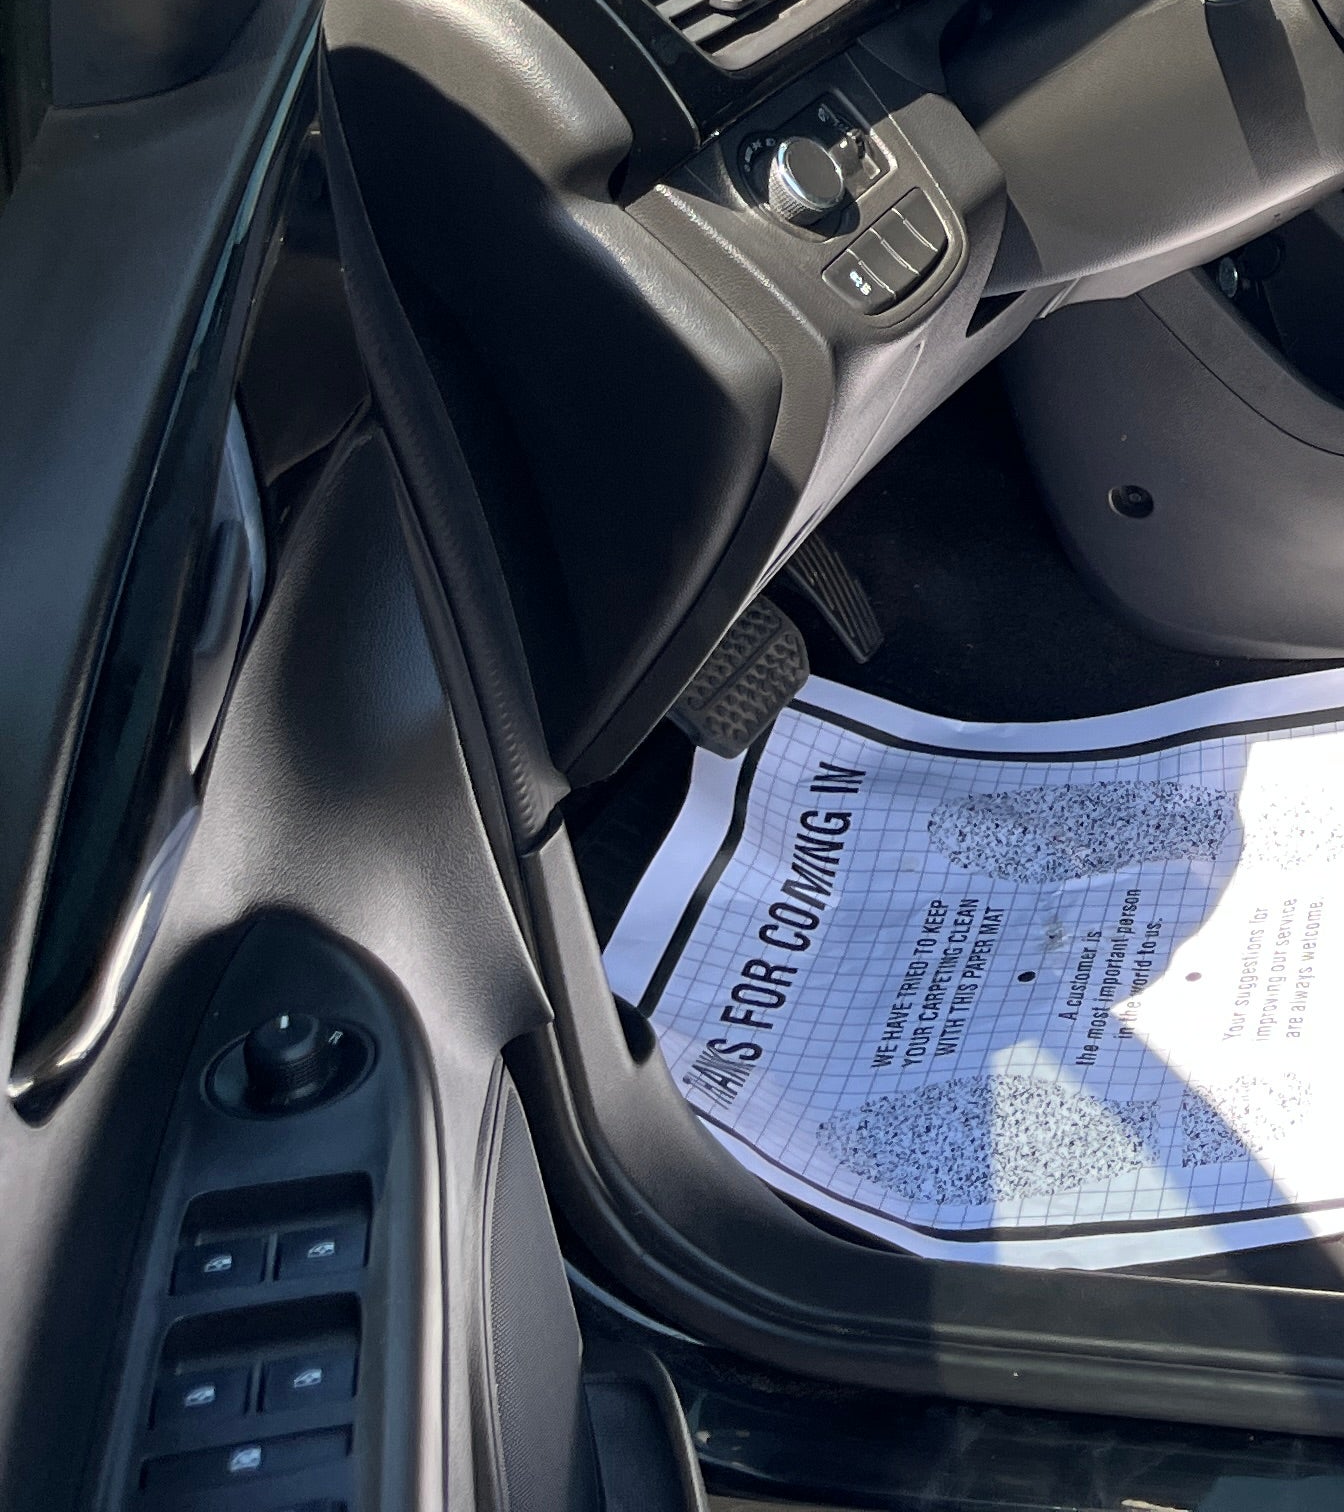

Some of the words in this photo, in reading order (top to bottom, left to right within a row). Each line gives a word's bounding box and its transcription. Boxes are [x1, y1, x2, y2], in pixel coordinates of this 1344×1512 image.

[809, 761, 866, 793] IN
[758, 810, 852, 951] COMING
[921, 899, 949, 934] KEEP
[979, 906, 1004, 935] MAT
[1117, 888, 1141, 935] person
[1145, 918, 1163, 937] us.
[1276, 899, 1297, 946] service
[913, 938, 937, 956] TO
[1082, 930, 1102, 942] is
[1137, 940, 1157, 955] to
[962, 939, 995, 979] PAPER
[1066, 946, 1098, 1007] customer
[1093, 939, 1129, 1002] important
[1270, 950, 1287, 972] our
[719, 958, 799, 1029] FOR
[897, 961, 929, 998] TRIED
[901, 1026, 934, 1068] YOUR
[918, 947, 963, 1021] CARPETING
[948, 898, 980, 943] CLEAN
[1130, 959, 1153, 996] world
[1222, 1012, 1246, 1041] Your
[1235, 929, 1265, 1006] suggestions
[1289, 966, 1315, 1012] always
[949, 983, 978, 1014] THIS
[1058, 1012, 1078, 1021] A
[1119, 1001, 1141, 1022] the
[1255, 976, 1286, 1041] improving
[882, 1002, 912, 1040] HAVE
[934, 1018, 966, 1057] WITH
[1087, 1007, 1110, 1039] most
[1113, 1027, 1135, 1039] in
[1286, 1017, 1303, 1038] are
[871, 1044, 898, 1068] WE
[1075, 1044, 1099, 1066] the
[682, 1038, 763, 1110] THANKS
